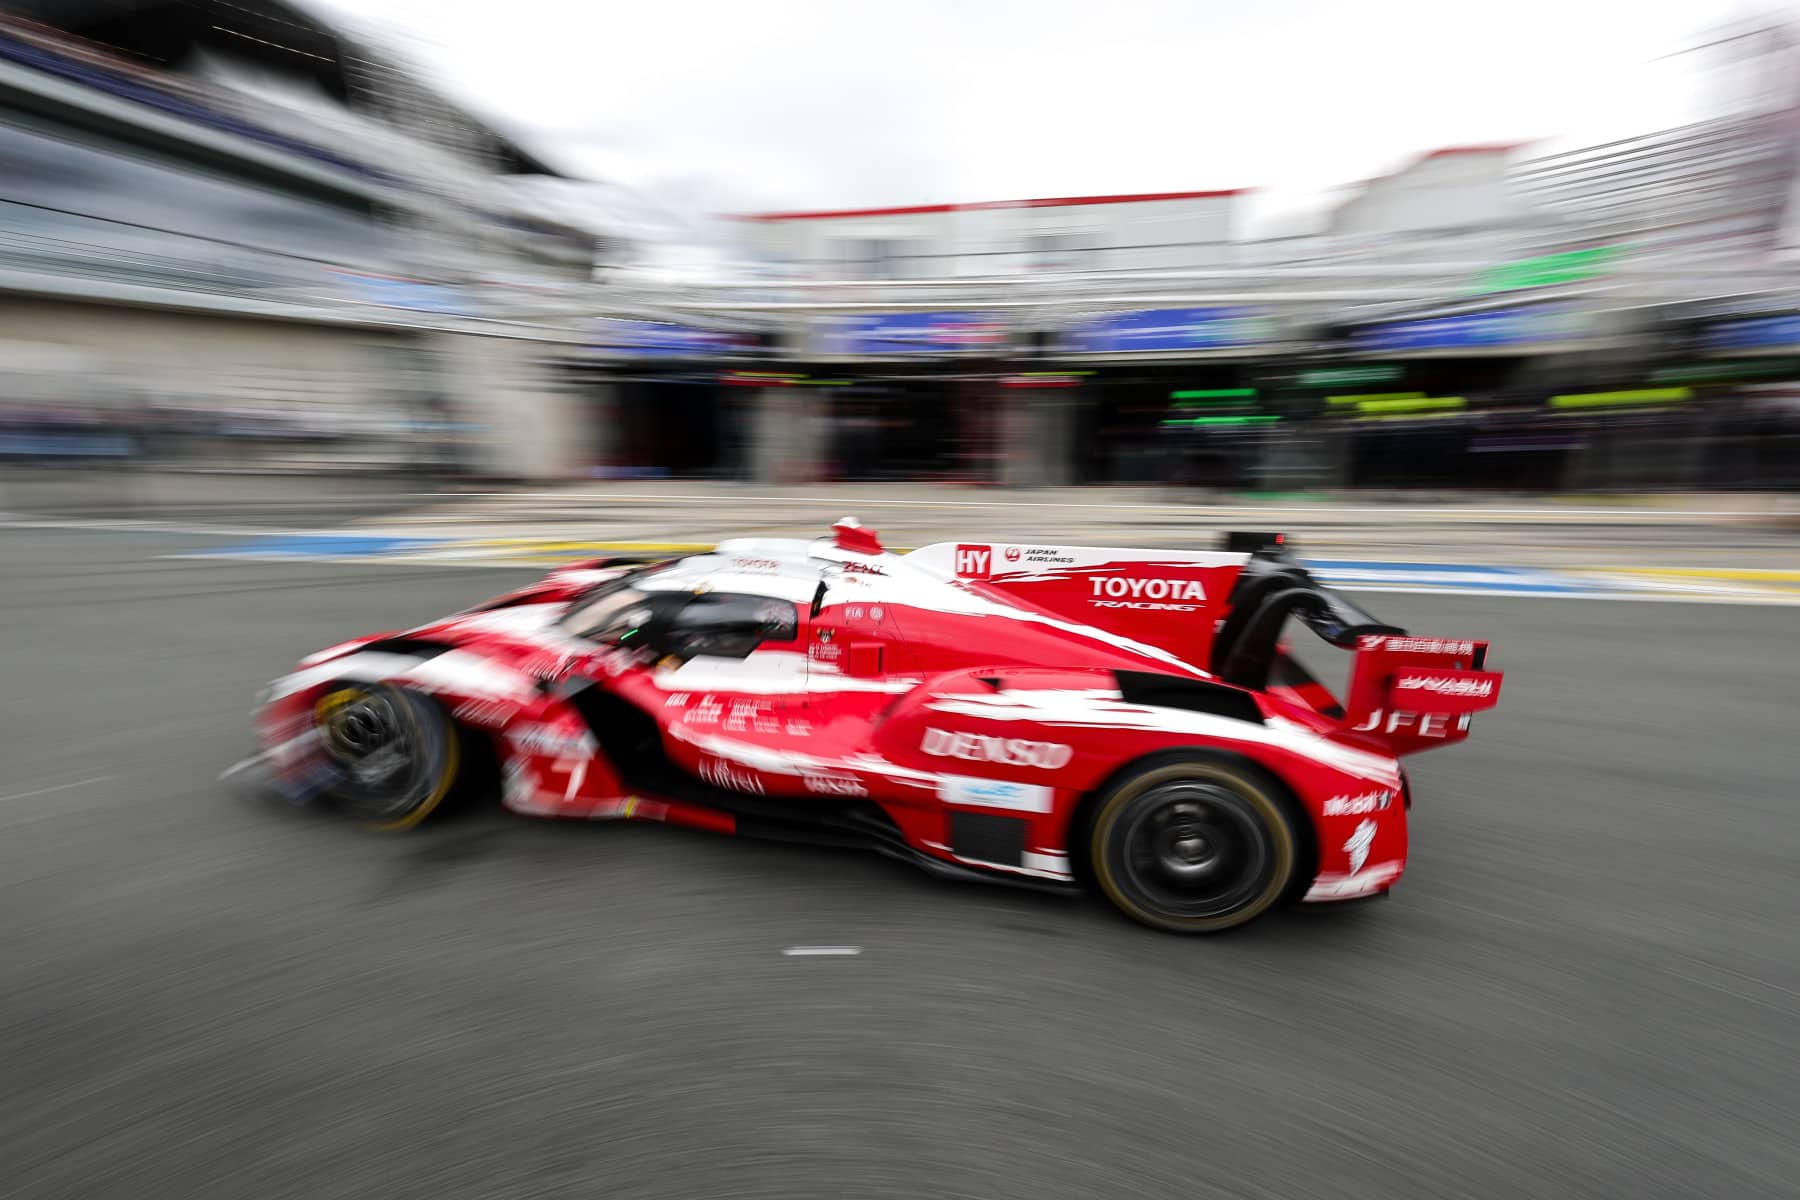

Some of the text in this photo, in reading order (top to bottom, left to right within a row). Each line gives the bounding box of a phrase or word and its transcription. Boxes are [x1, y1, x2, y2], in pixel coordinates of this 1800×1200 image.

[956, 549, 990, 574] HY
[1088, 576, 1207, 600] TOYOTA
[1088, 600, 1207, 612] RACING
[1351, 708, 1450, 738] JFE
[920, 727, 1073, 769] DENSO
[1322, 790, 1378, 816] Mobil
